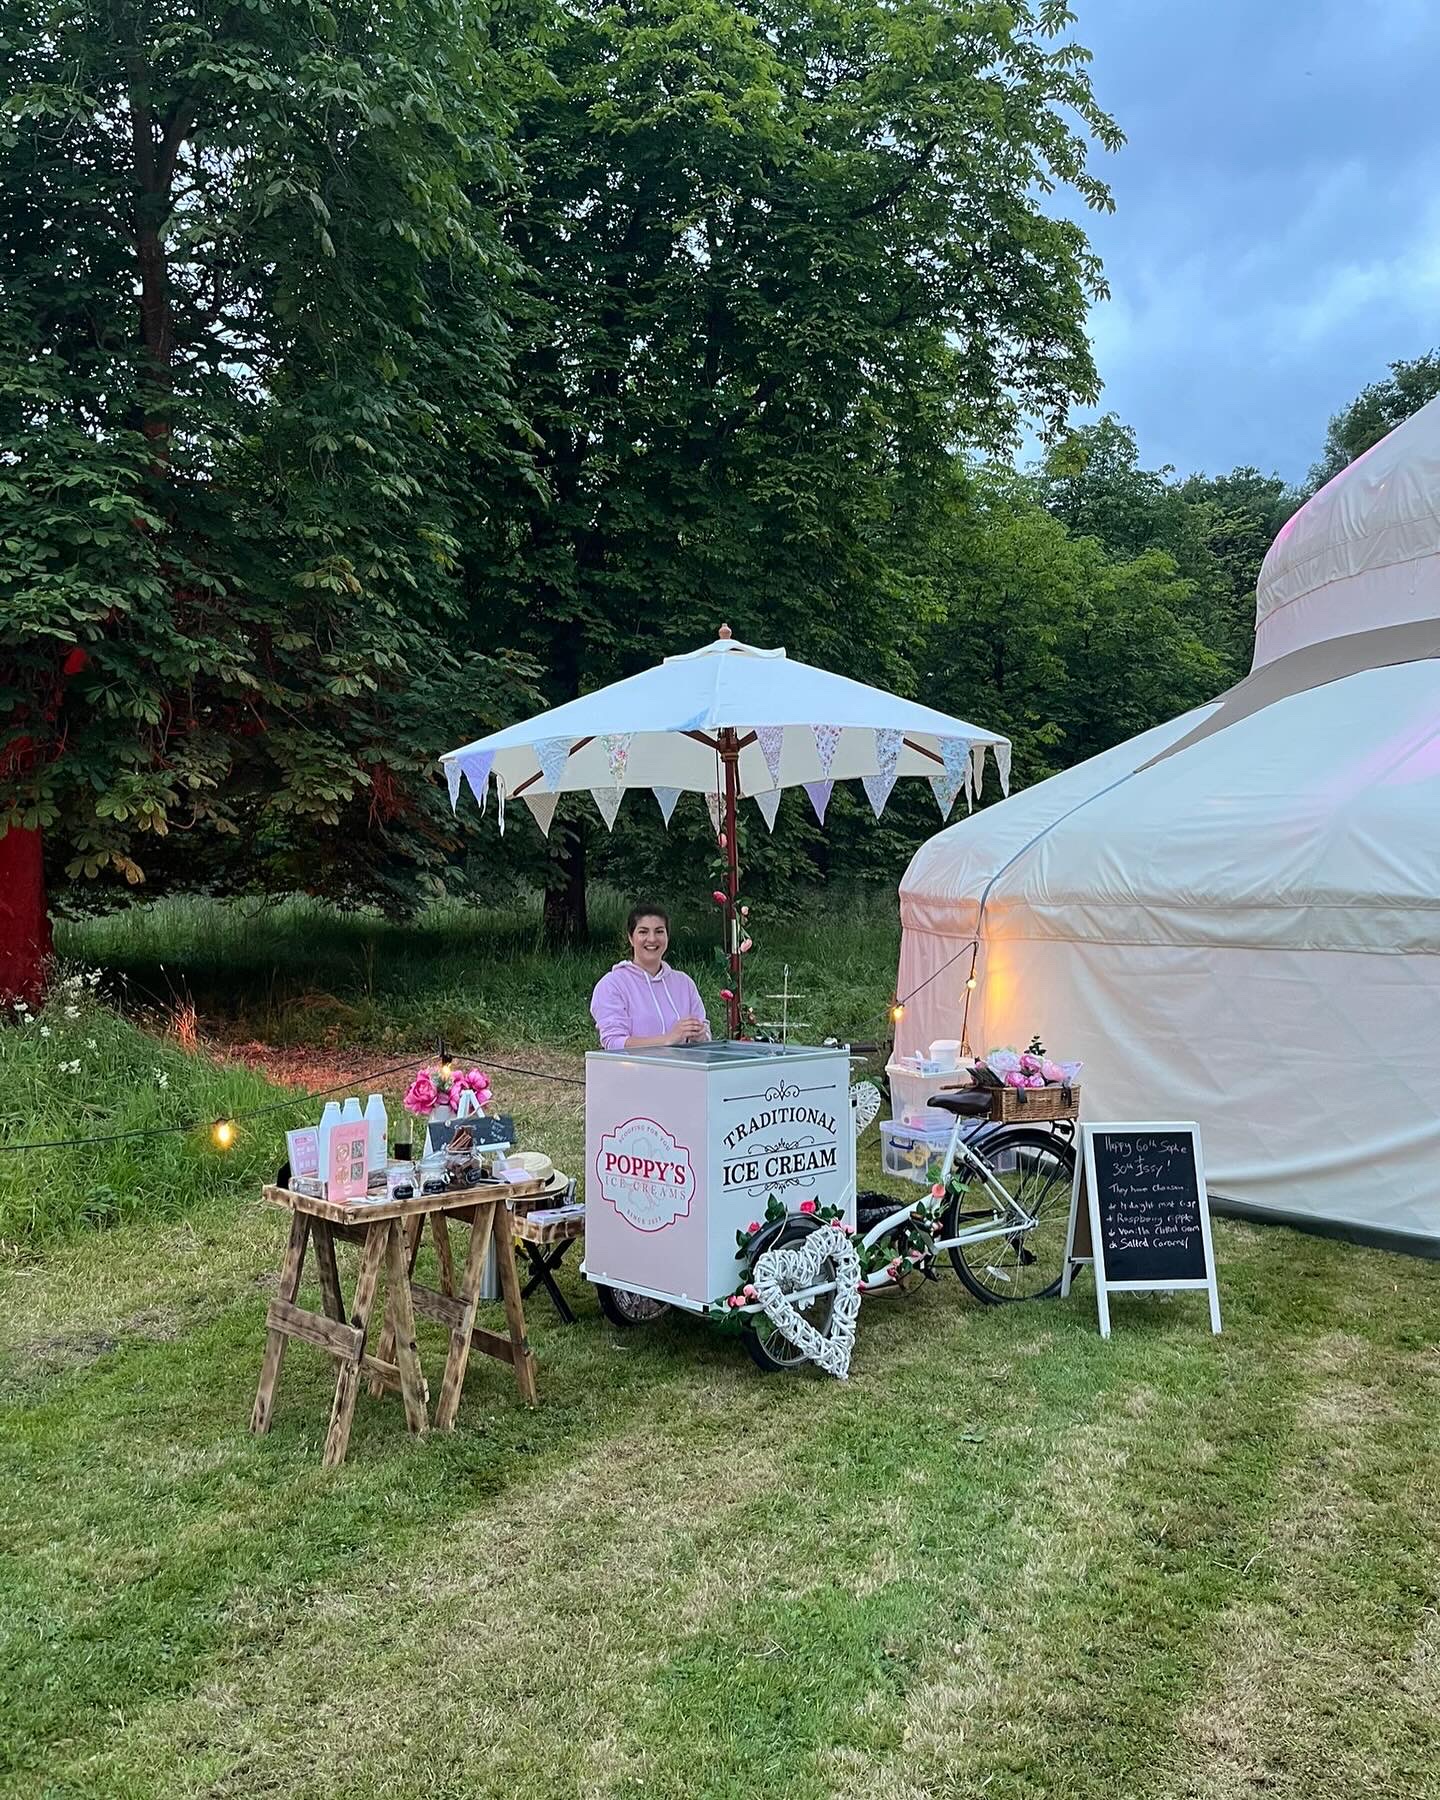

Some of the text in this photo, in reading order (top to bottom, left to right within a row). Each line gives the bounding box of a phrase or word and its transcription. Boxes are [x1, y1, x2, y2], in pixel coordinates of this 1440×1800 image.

[647, 1126, 659, 1137] FOR
[659, 1137, 671, 1152] YOU
[723, 1106, 837, 1150] TRADITIONAL
[1105, 1135, 1132, 1157] Happy
[1136, 1138, 1157, 1152] 60th
[605, 1152, 686, 1185] POPPY'S
[723, 1148, 837, 1186] ICE CREAM
[605, 1175, 686, 1201] ICE CREAMS
[1108, 1183, 1128, 1197] They
[1120, 1237, 1149, 1250] Salted
